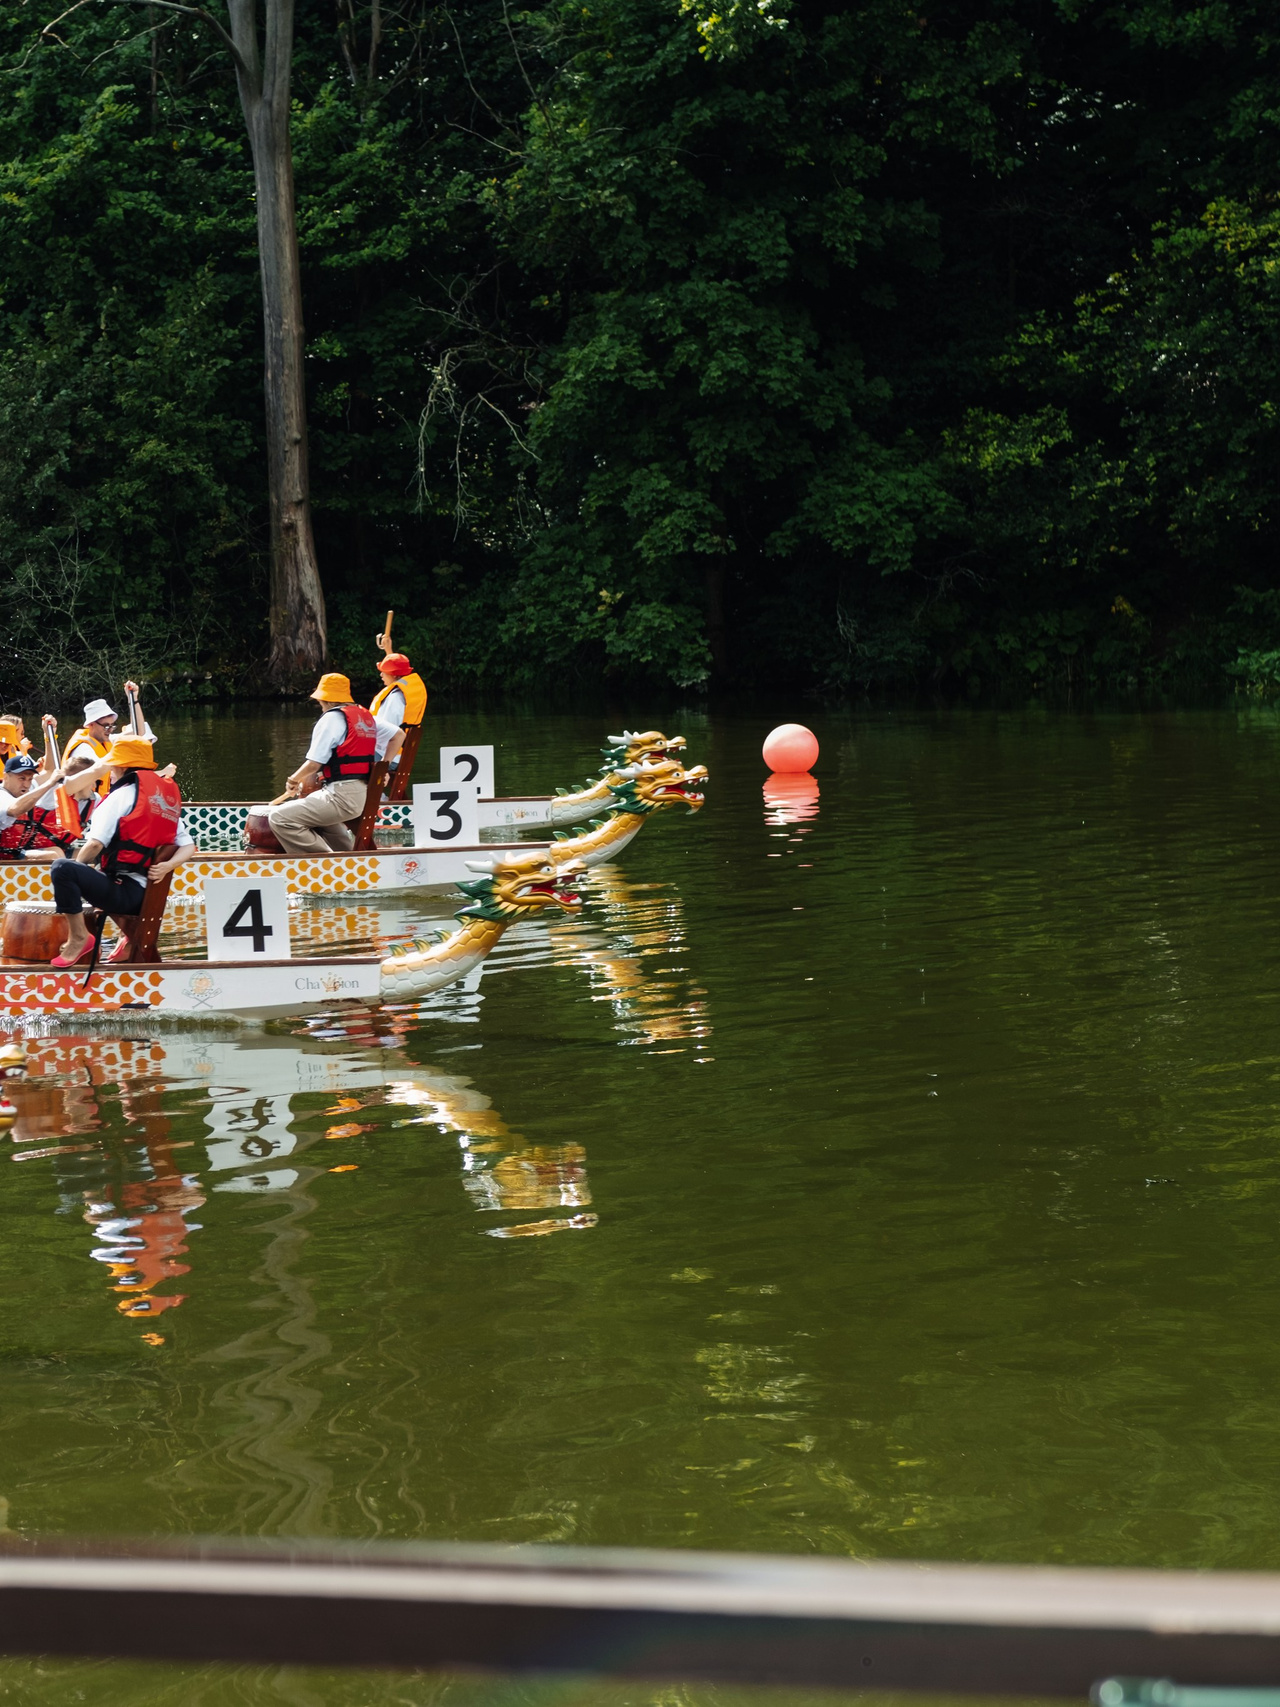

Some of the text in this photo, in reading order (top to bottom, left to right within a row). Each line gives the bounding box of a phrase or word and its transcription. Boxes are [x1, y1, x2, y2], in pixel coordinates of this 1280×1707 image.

[454, 754, 481, 794] 2
[430, 791, 462, 840] 3
[223, 890, 272, 952] 4
[295, 977, 360, 992] Chapion
